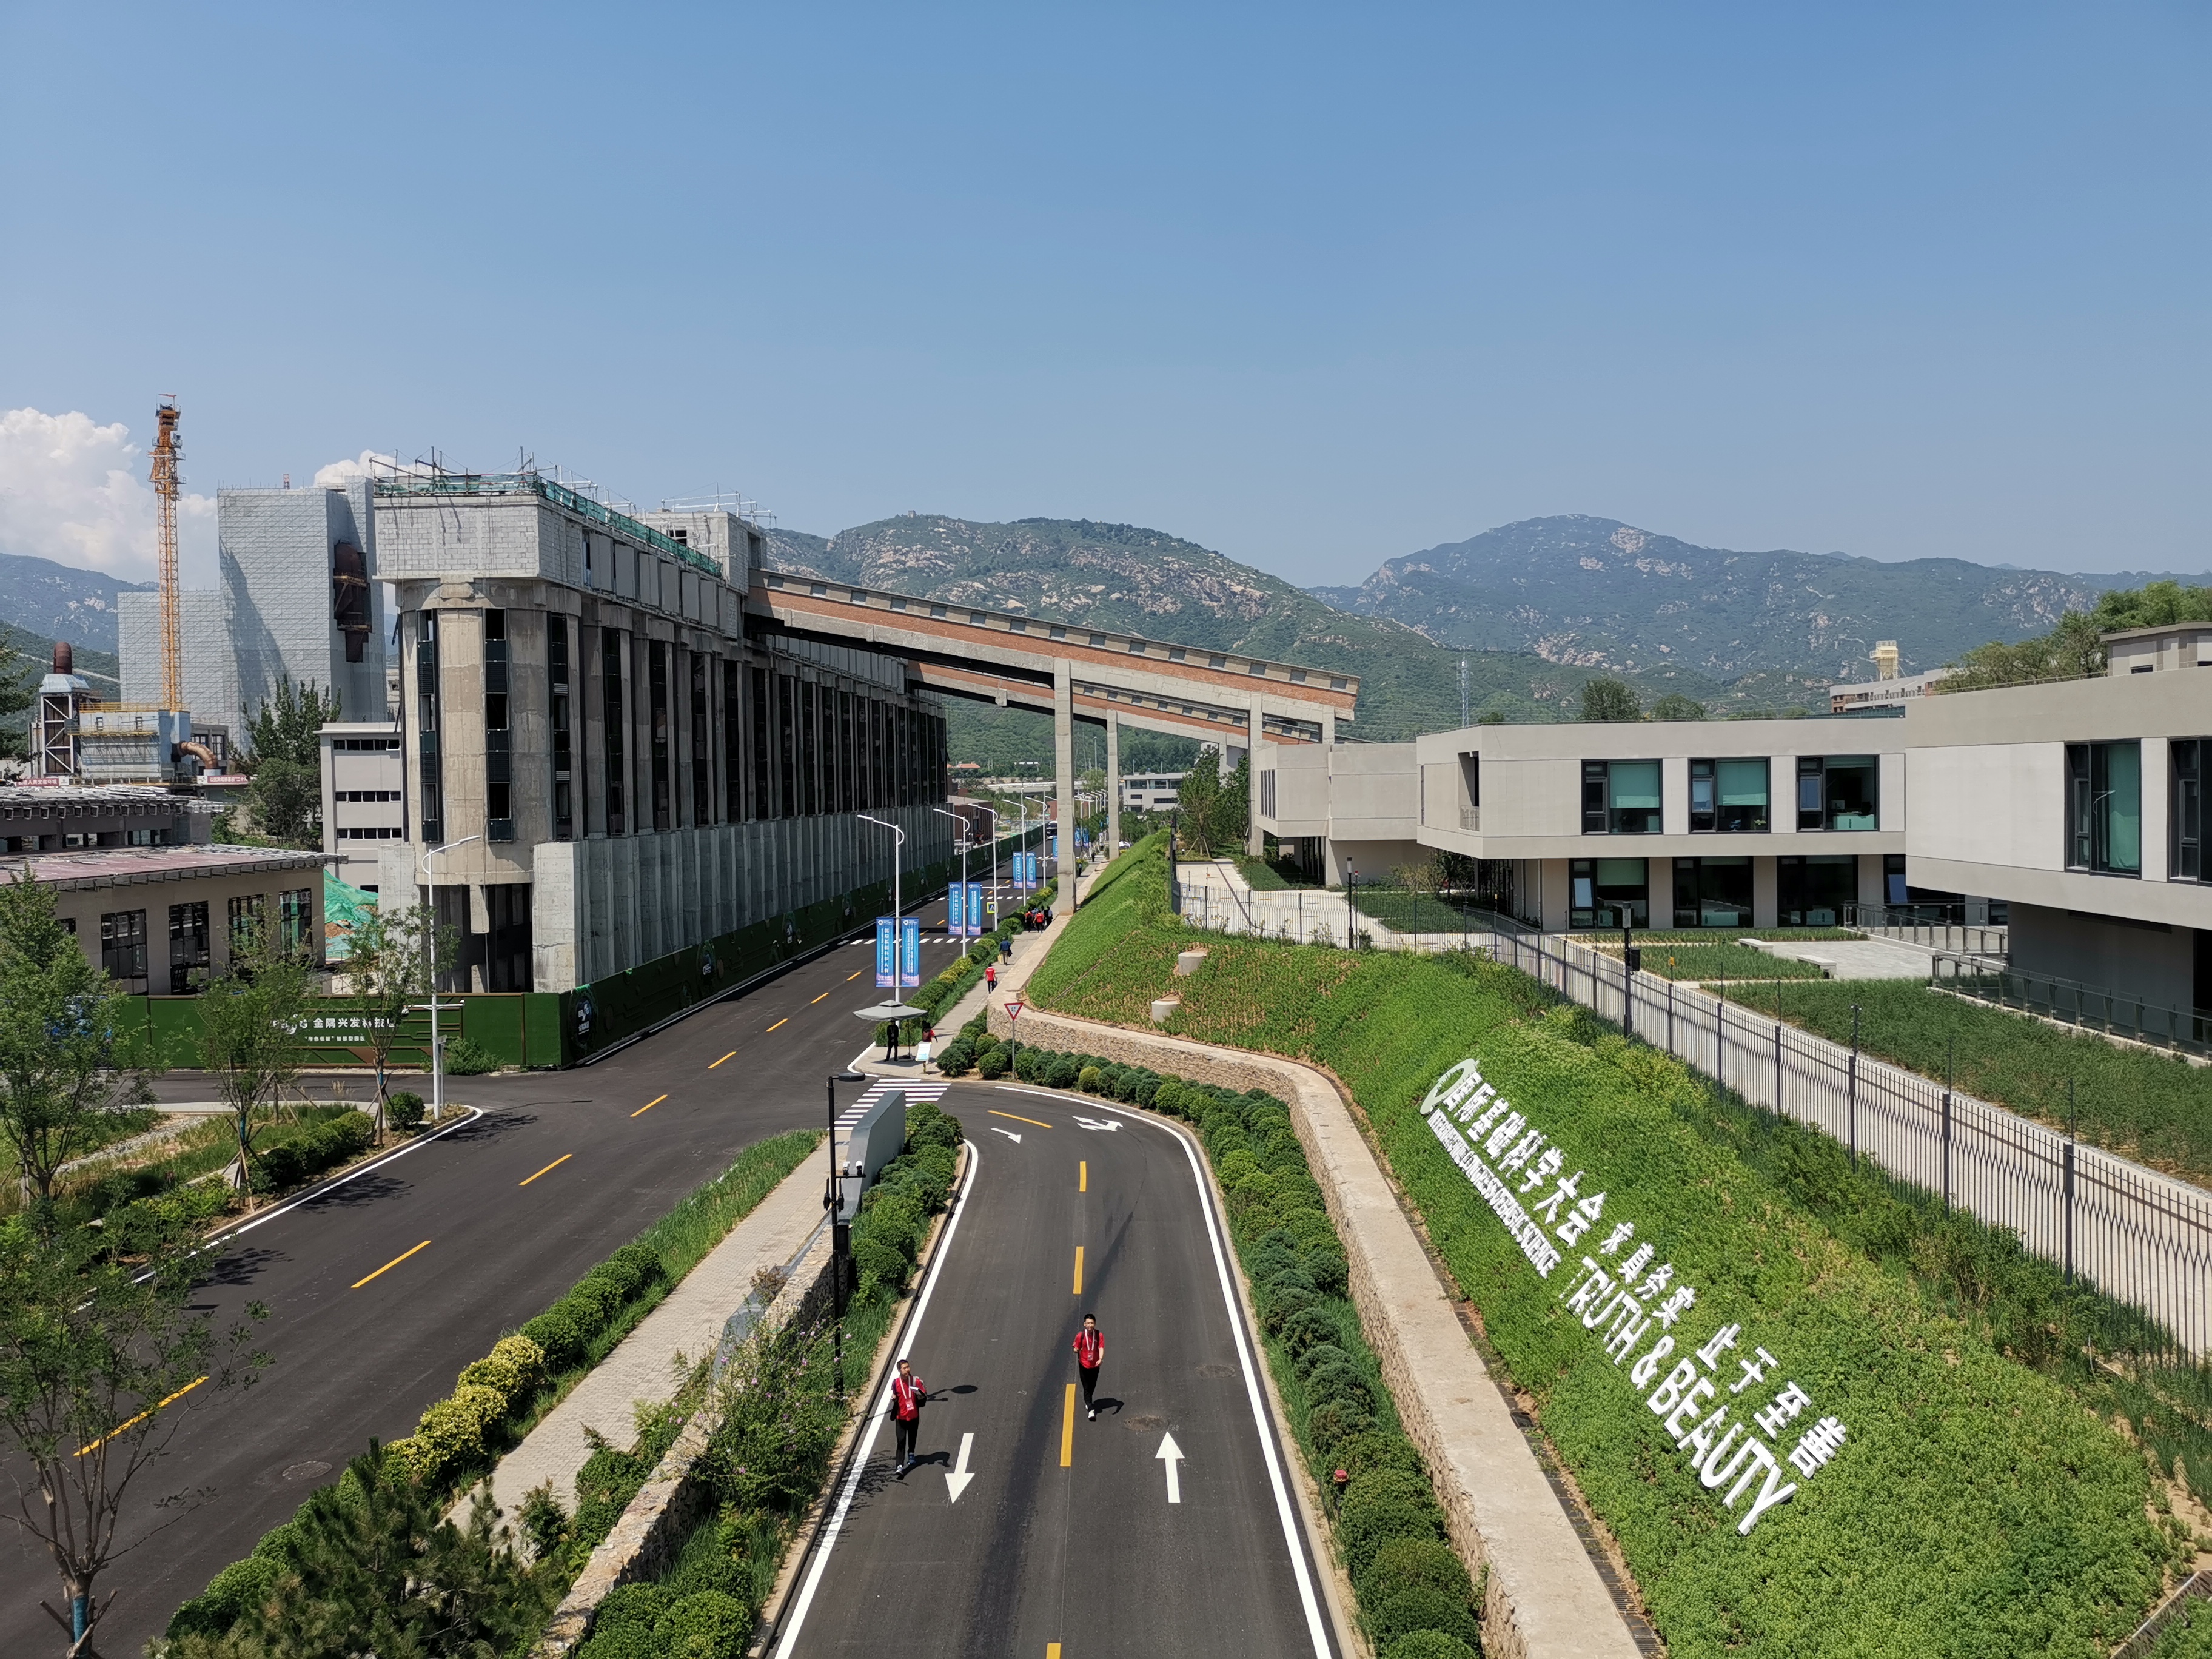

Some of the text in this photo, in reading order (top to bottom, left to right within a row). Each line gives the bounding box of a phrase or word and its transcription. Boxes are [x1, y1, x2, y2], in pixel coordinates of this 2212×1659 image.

[1443, 1071, 1607, 1248] 国际基础科学大会
[1559, 1256, 1798, 1536] TRUTH & BEAUTY
[1600, 1222, 1847, 1479] 求真务实 止于至善
